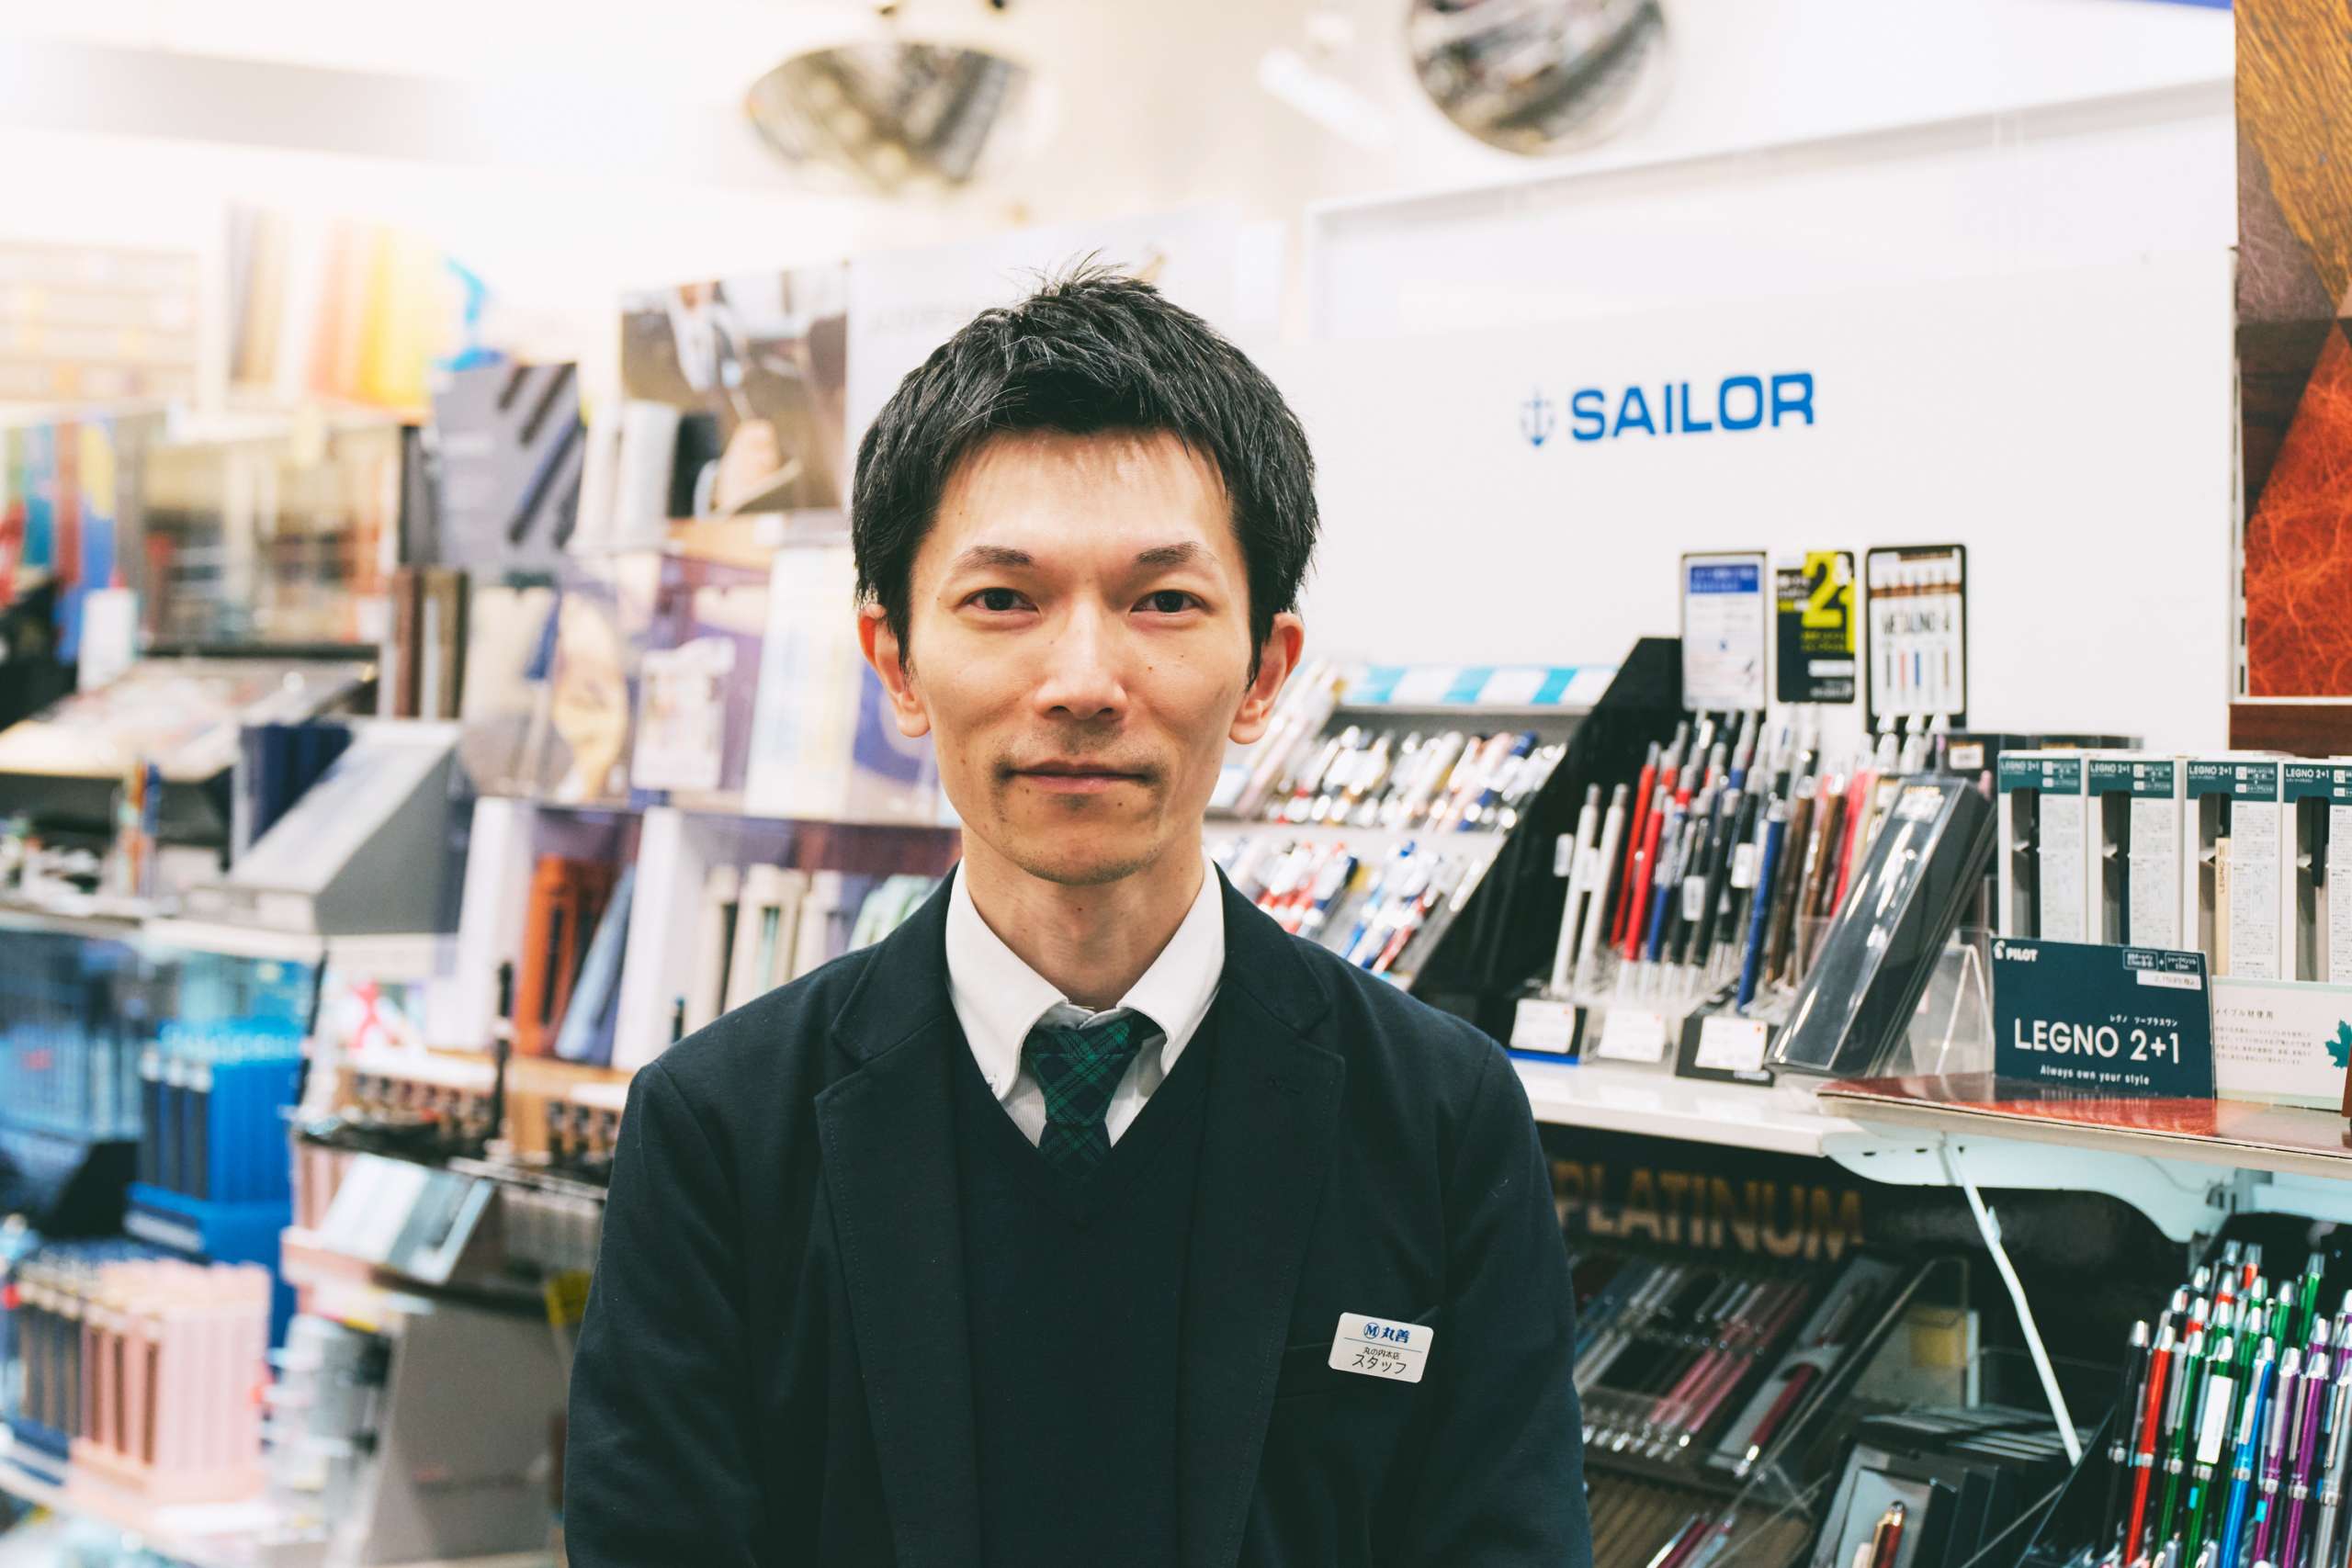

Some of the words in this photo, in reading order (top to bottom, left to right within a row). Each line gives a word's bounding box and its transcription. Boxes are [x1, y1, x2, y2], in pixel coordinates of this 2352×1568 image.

[1570, 372, 1815, 442] SAILOR
[2089, 763, 2117, 774] LEGNO
[2118, 764, 2131, 774] 2+1
[2188, 765, 2217, 776] LEGNO
[2219, 766, 2233, 776] 2+1
[2285, 768, 2314, 779] LEGNO
[2316, 769, 2330, 780] 2+1
[2006, 947, 2039, 963] PILOT
[2014, 1017, 2120, 1058] LEGNO
[2130, 1029, 2180, 1065] 2+1
[2040, 1065, 2074, 1079] Always
[2076, 1070, 2097, 1080] own
[2099, 1071, 2122, 1083] your
[2124, 1074, 2151, 1087] style
[1554, 1161, 1864, 1259] PLATINUM
[1382, 1327, 1409, 1343] 丸善
[1363, 1347, 1400, 1359] 丸の内本店
[1352, 1354, 1407, 1374] スタッフ
